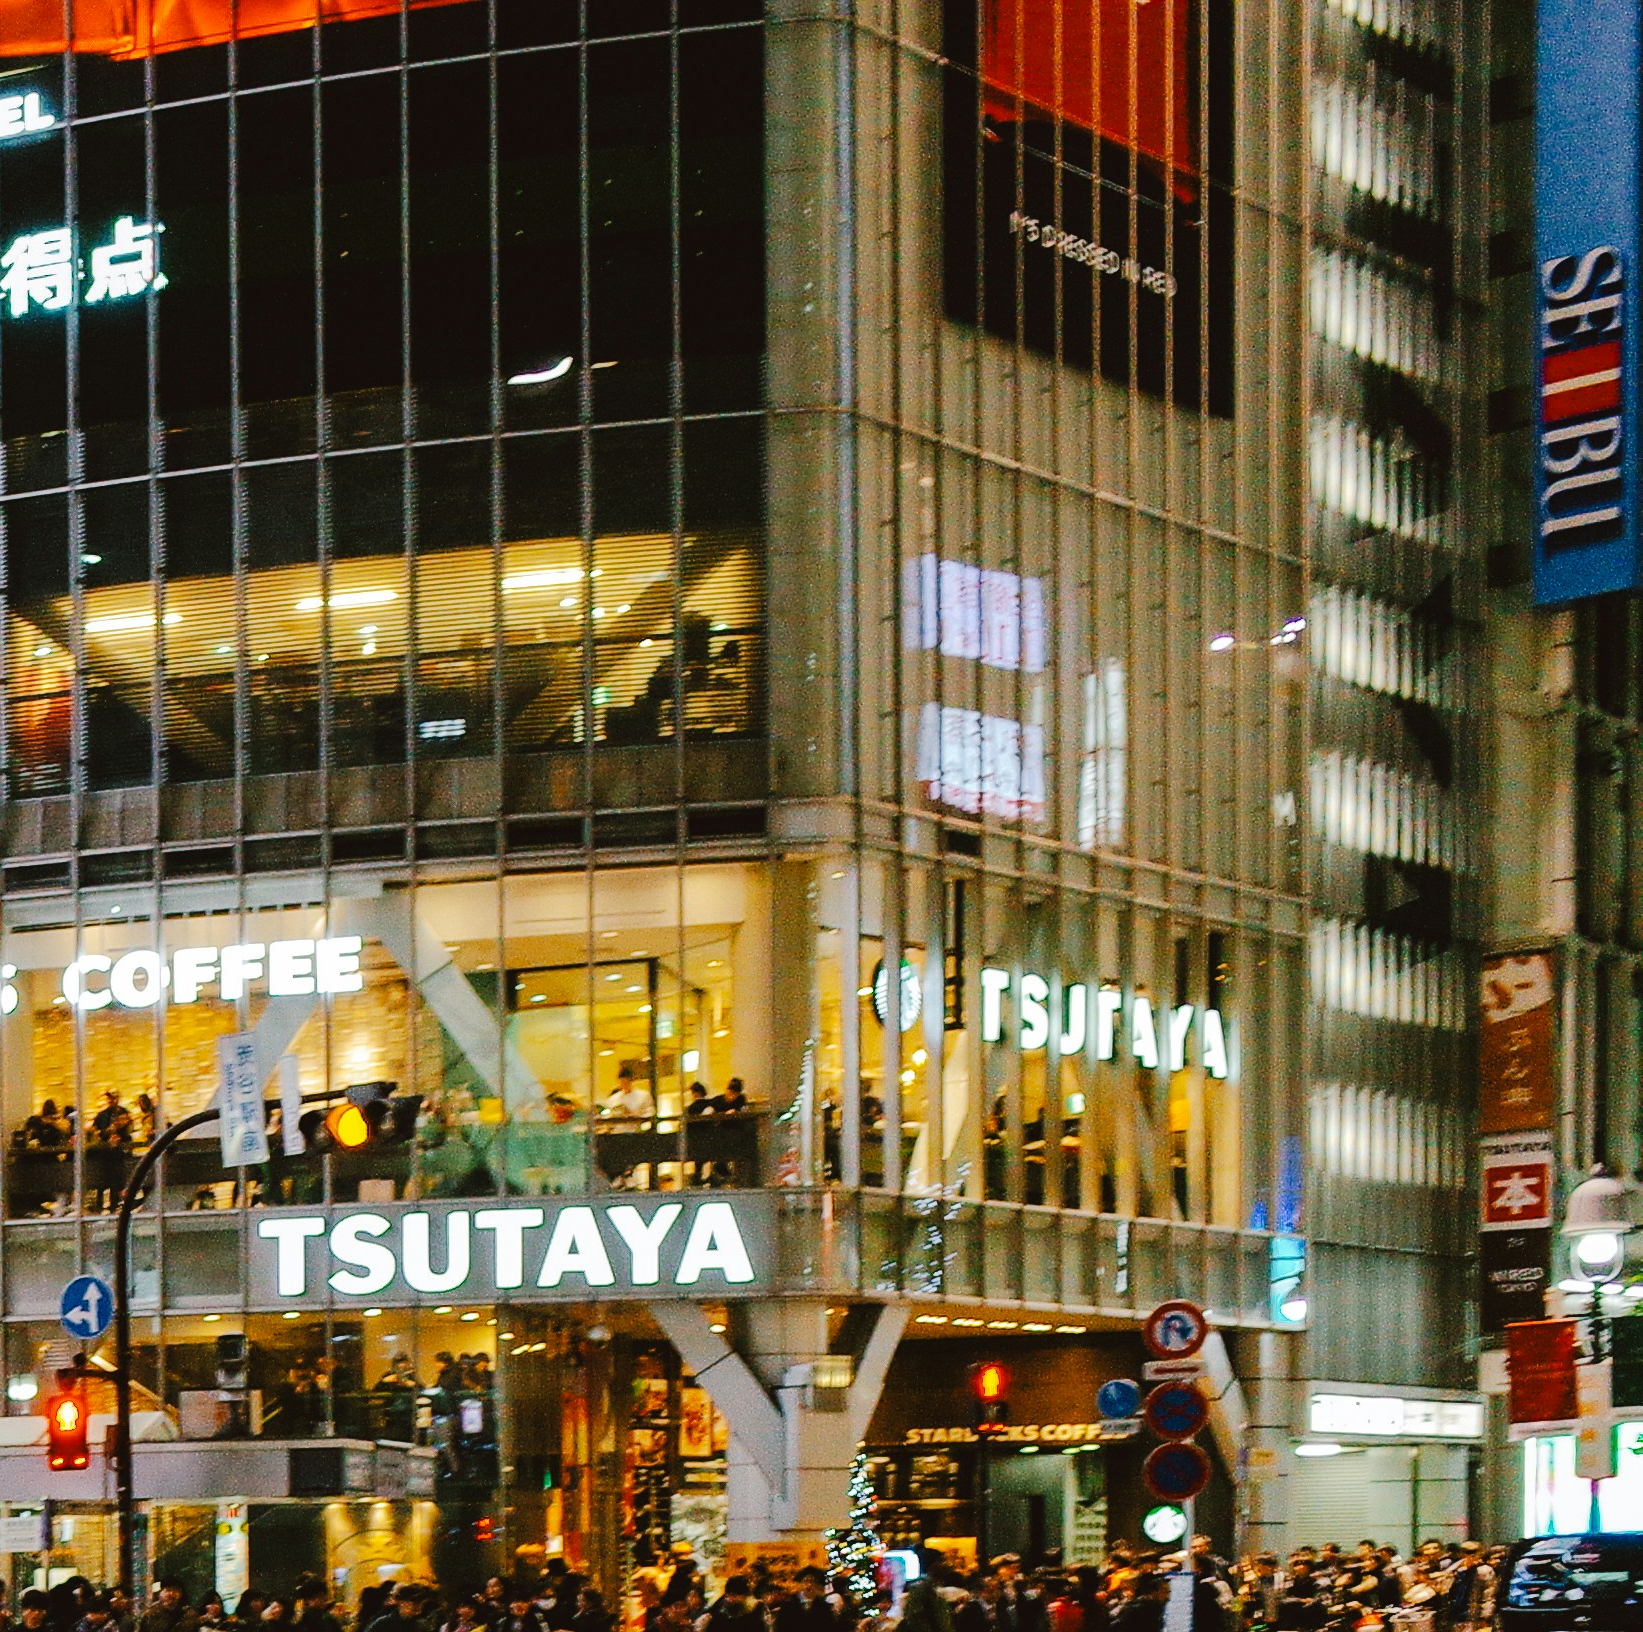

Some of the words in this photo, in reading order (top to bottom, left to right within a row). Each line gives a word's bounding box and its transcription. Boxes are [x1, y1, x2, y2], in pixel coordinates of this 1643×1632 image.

[1542, 246, 1623, 537] SEIBU
[62, 936, 365, 1011] COFFEE
[1493, 1171, 1541, 1216] 本
[258, 1202, 756, 1297] TSUTAYA
